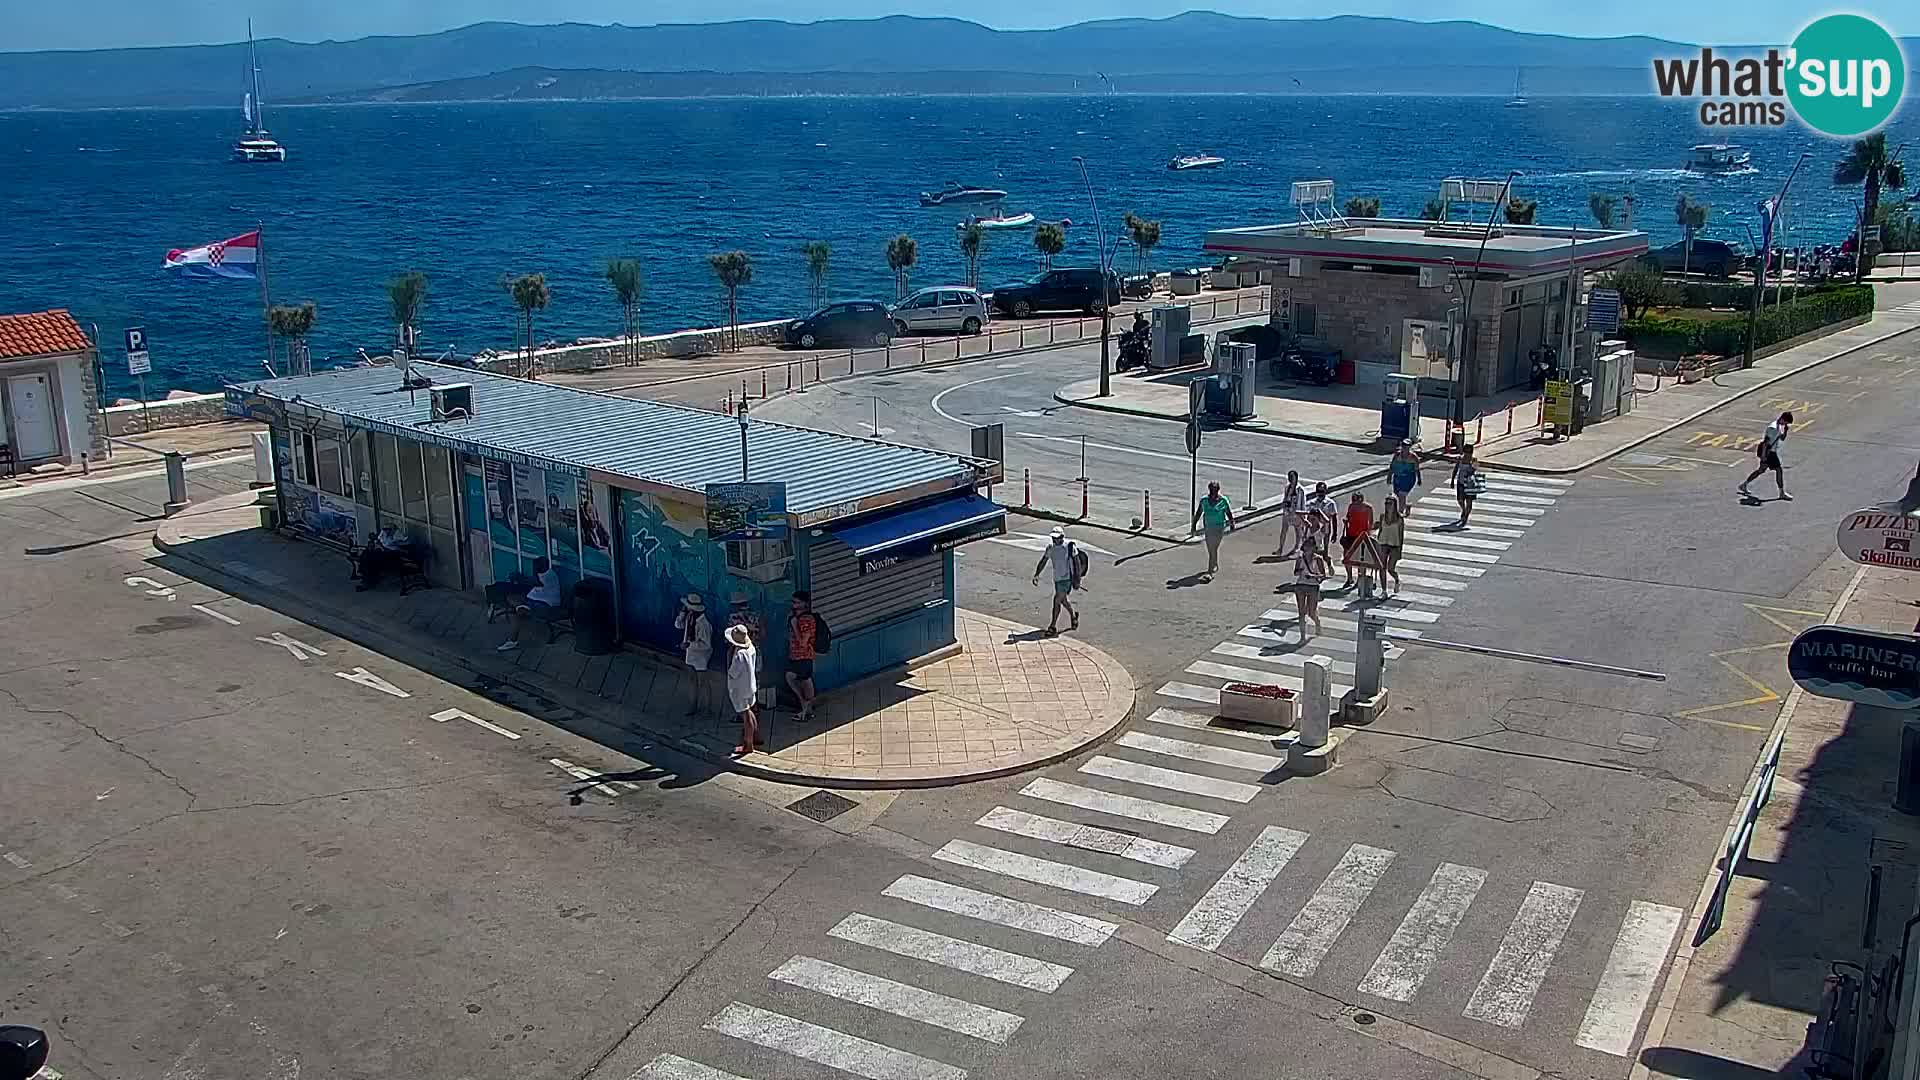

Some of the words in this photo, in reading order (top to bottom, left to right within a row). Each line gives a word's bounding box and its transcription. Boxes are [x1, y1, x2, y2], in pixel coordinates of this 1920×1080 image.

[129, 330, 142, 349] P
[436, 437, 467, 451] POSTAJA
[478, 446, 492, 457] BUS
[493, 449, 526, 465] STATION
[528, 456, 554, 471] TICKET
[555, 461, 582, 476] OFFICE
[1848, 515, 1920, 532] PIZZE
[1870, 665, 1897, 680] bar
